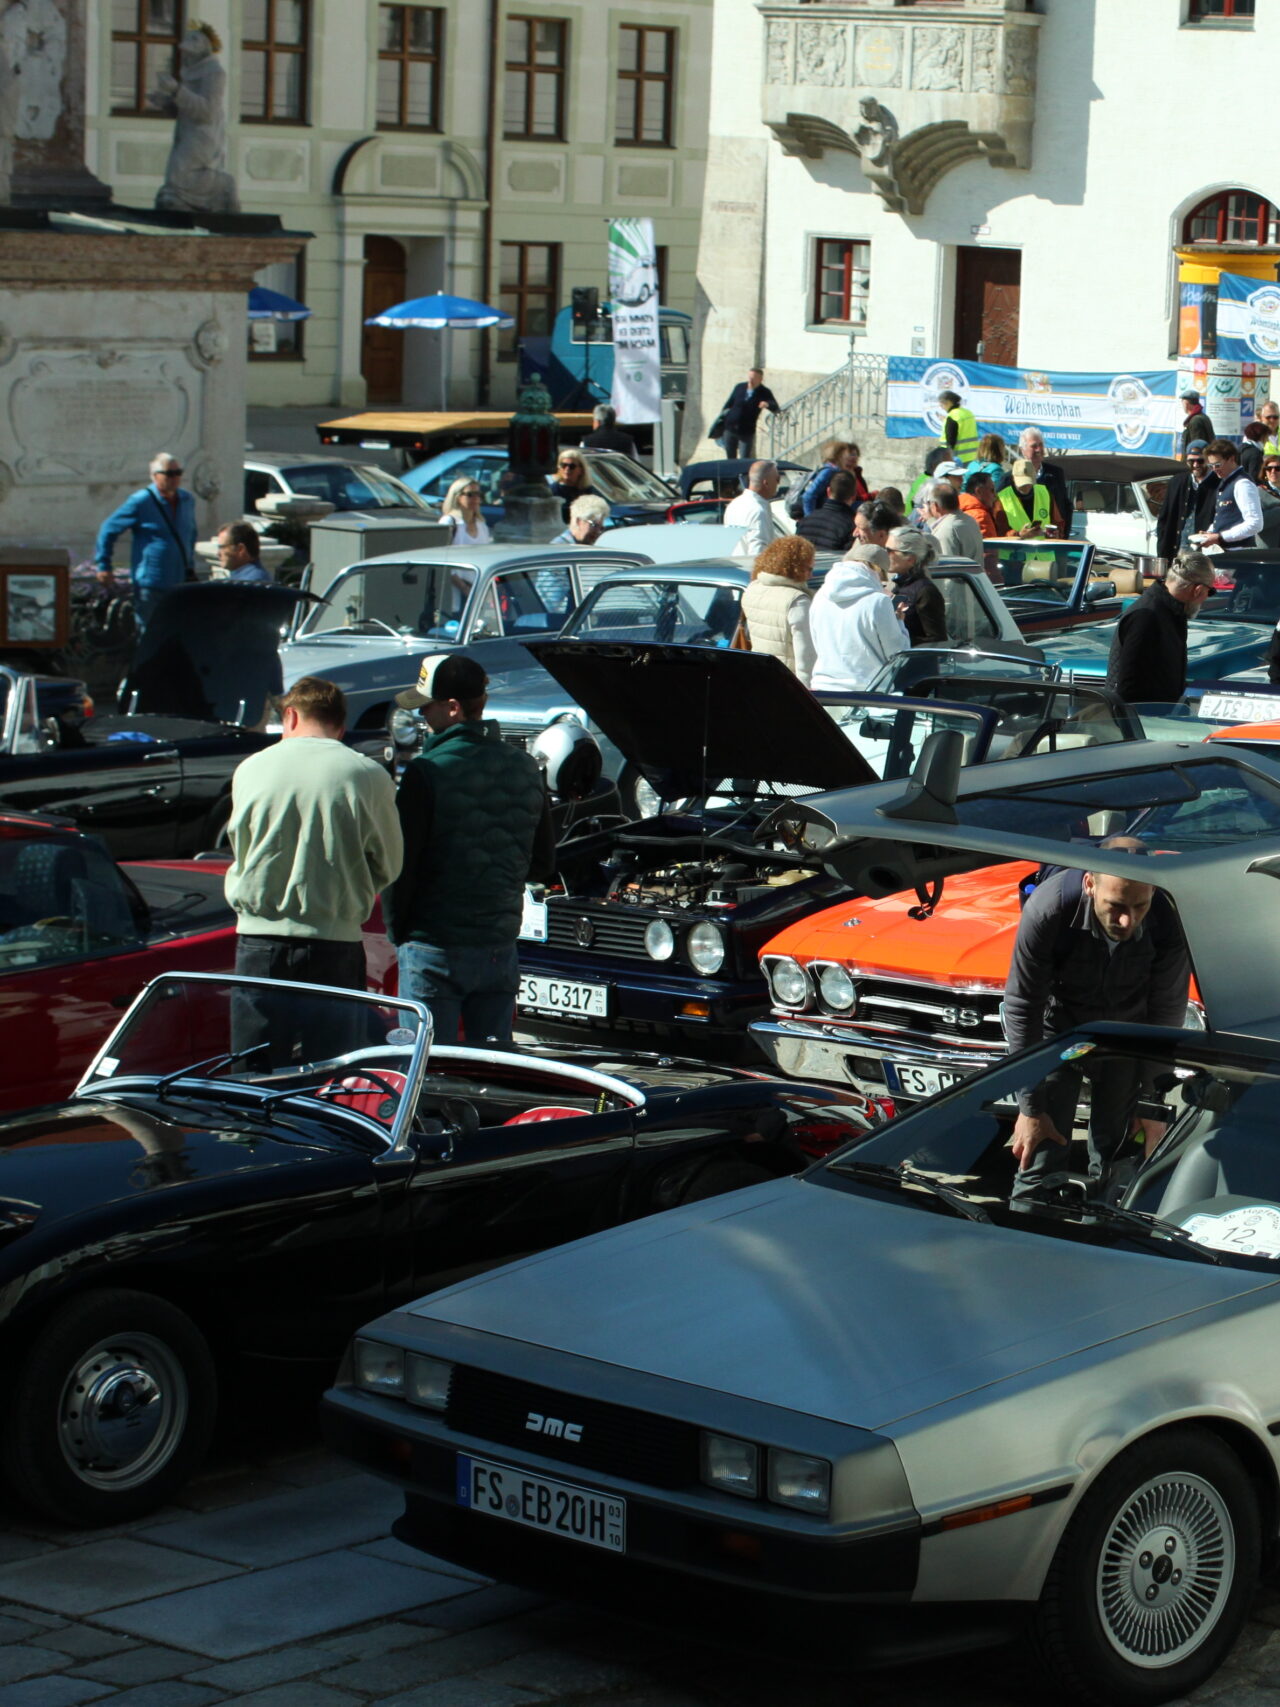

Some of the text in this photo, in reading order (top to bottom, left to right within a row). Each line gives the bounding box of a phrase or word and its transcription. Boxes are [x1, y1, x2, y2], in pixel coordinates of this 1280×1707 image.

[1003, 394, 1082, 420] Weihenstephan
[517, 979, 592, 1010] FS C317
[942, 1006, 979, 1027] SS
[897, 1067, 927, 1093] FS
[1222, 1226, 1256, 1244] 12
[473, 1466, 504, 1511] FS
[608, 1504, 621, 1519] 03
[609, 1532, 621, 1547] 10
